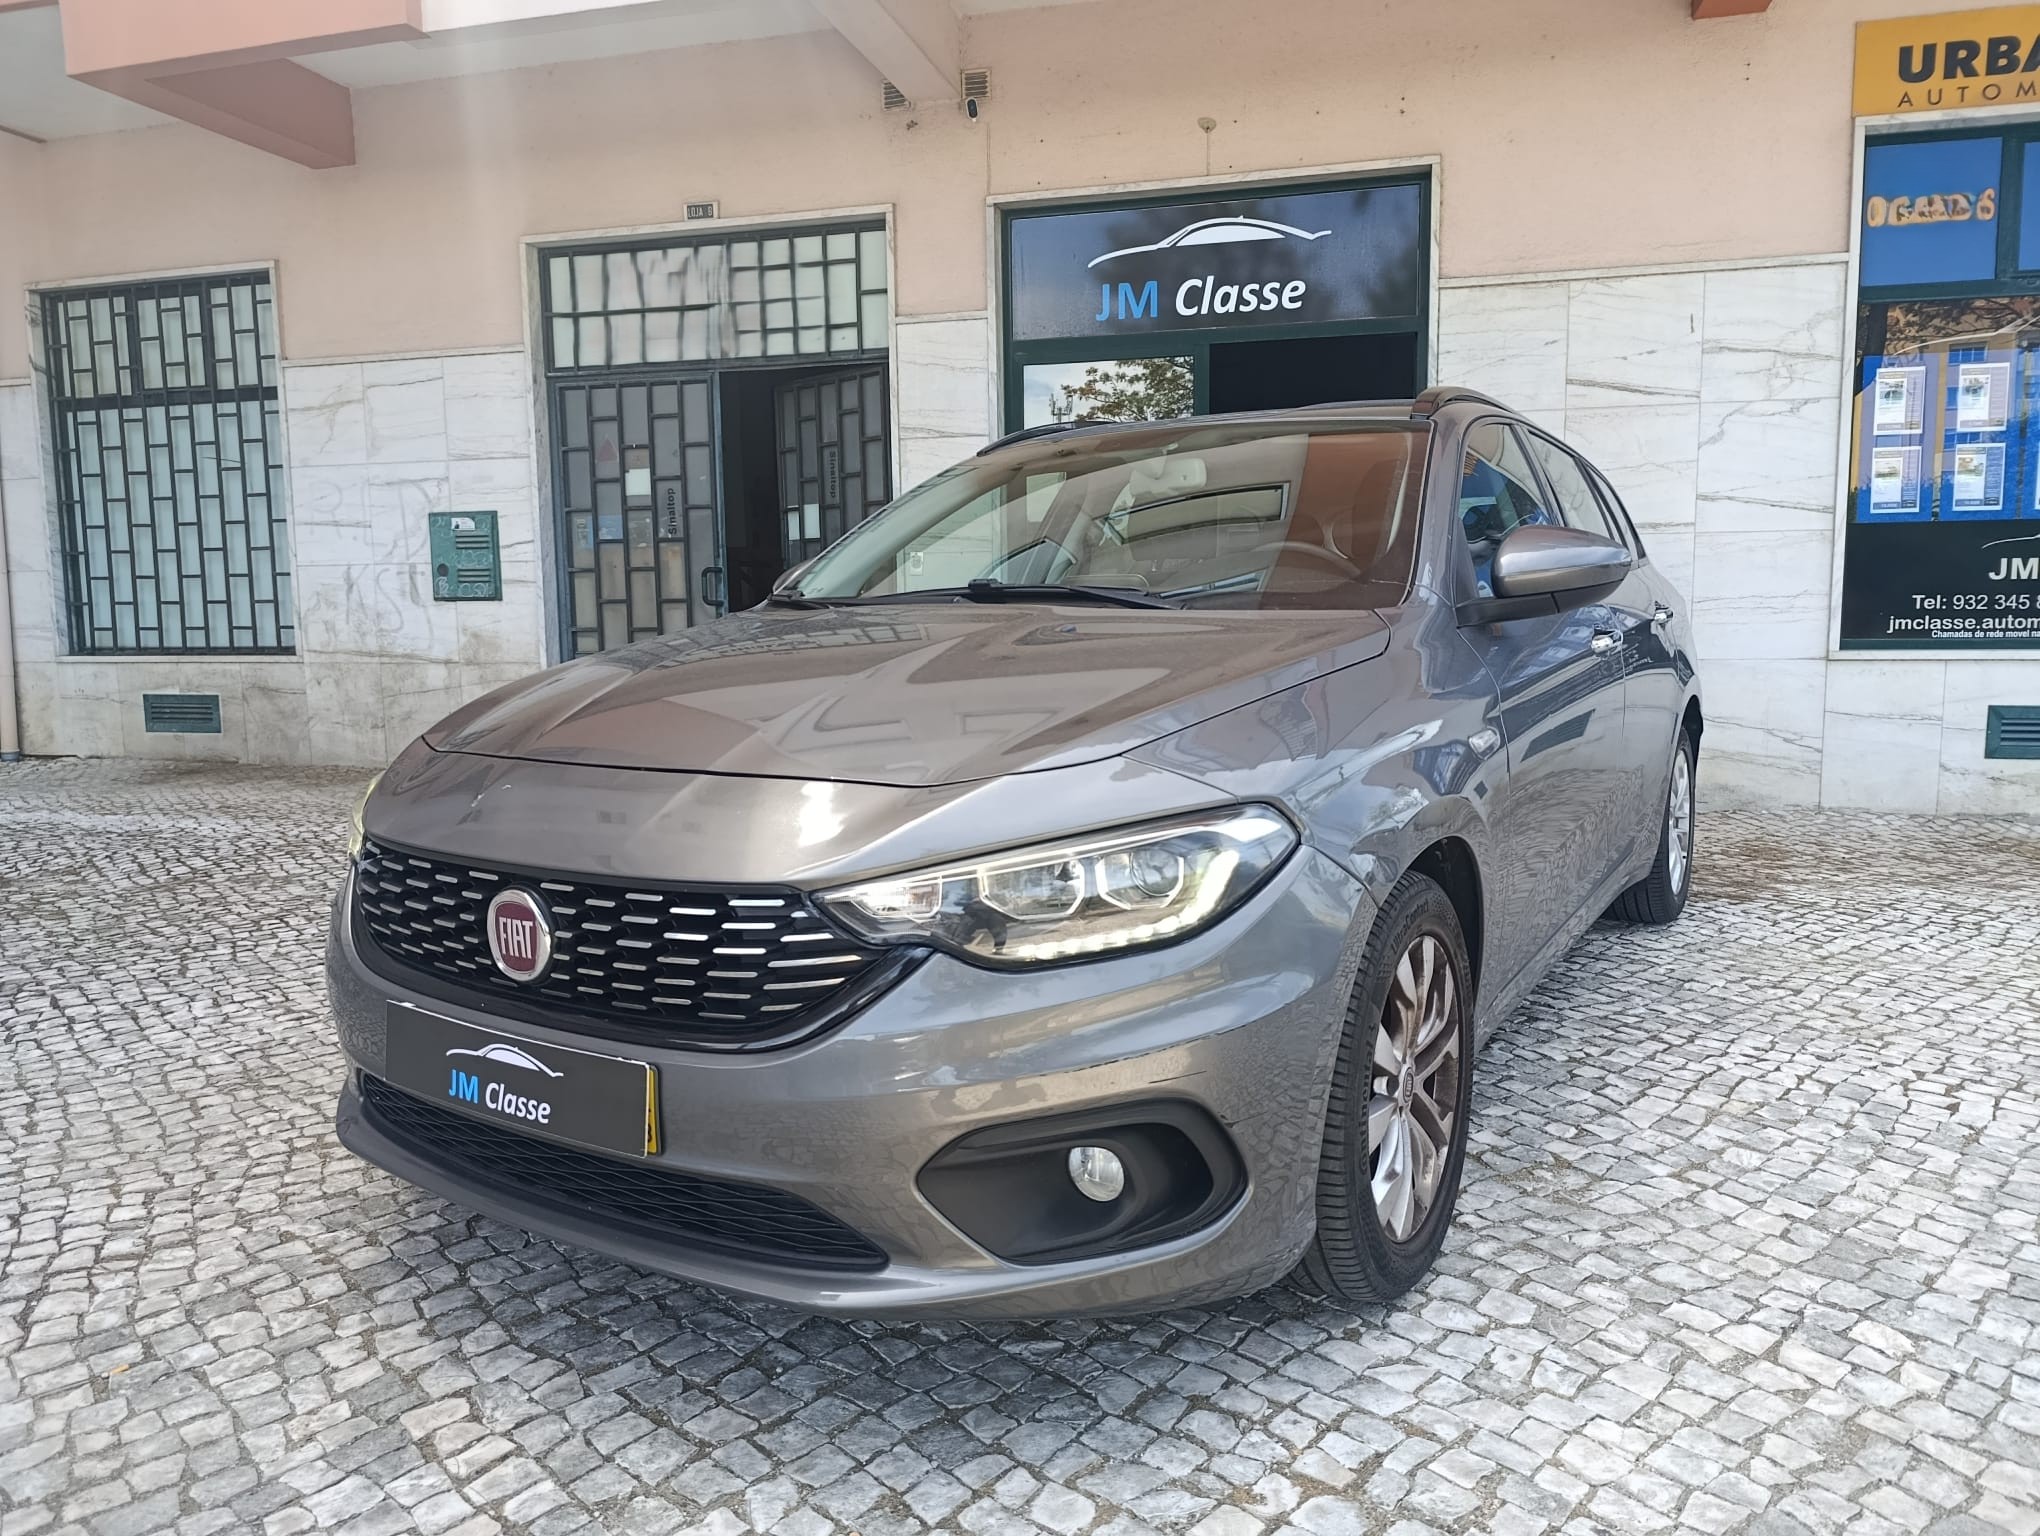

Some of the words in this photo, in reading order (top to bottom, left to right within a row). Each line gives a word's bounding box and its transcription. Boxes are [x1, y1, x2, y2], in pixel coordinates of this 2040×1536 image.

[1897, 81, 2037, 107] AUTOM
[688, 207, 703, 217] LOJA
[1096, 281, 1158, 321] JM
[1175, 275, 1306, 316] Classe
[667, 488, 677, 535] Sinaltop
[1988, 557, 2040, 580] JM
[1912, 594, 1947, 609] Tel:
[1953, 594, 1988, 610] 932
[1994, 594, 2030, 610] 345
[1886, 614, 2040, 634] jmclasse.autom
[1931, 630, 1973, 638] Chamadas
[1974, 630, 1984, 638] de
[1986, 630, 2004, 638] rede
[499, 917, 533, 960] FIAT
[448, 1069, 479, 1104] JM
[485, 1082, 551, 1124] Classe
